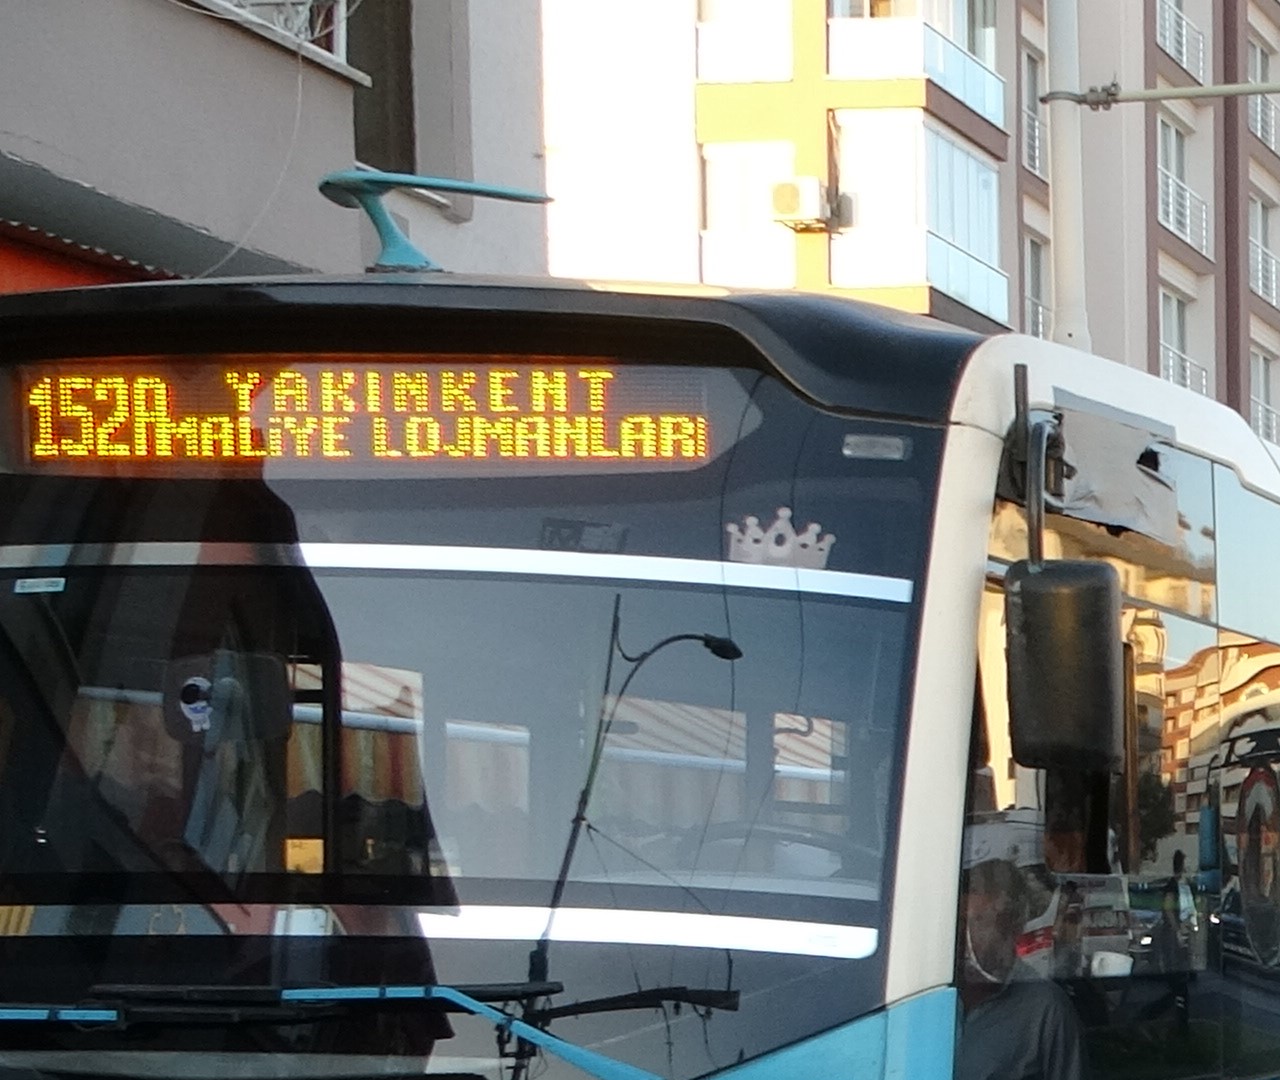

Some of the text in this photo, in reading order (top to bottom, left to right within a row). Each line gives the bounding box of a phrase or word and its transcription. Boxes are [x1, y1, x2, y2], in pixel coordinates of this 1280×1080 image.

[226, 370, 613, 412] YAKINKENT
[29, 377, 170, 456] 152A
[374, 416, 706, 457] LOJMANLARI
